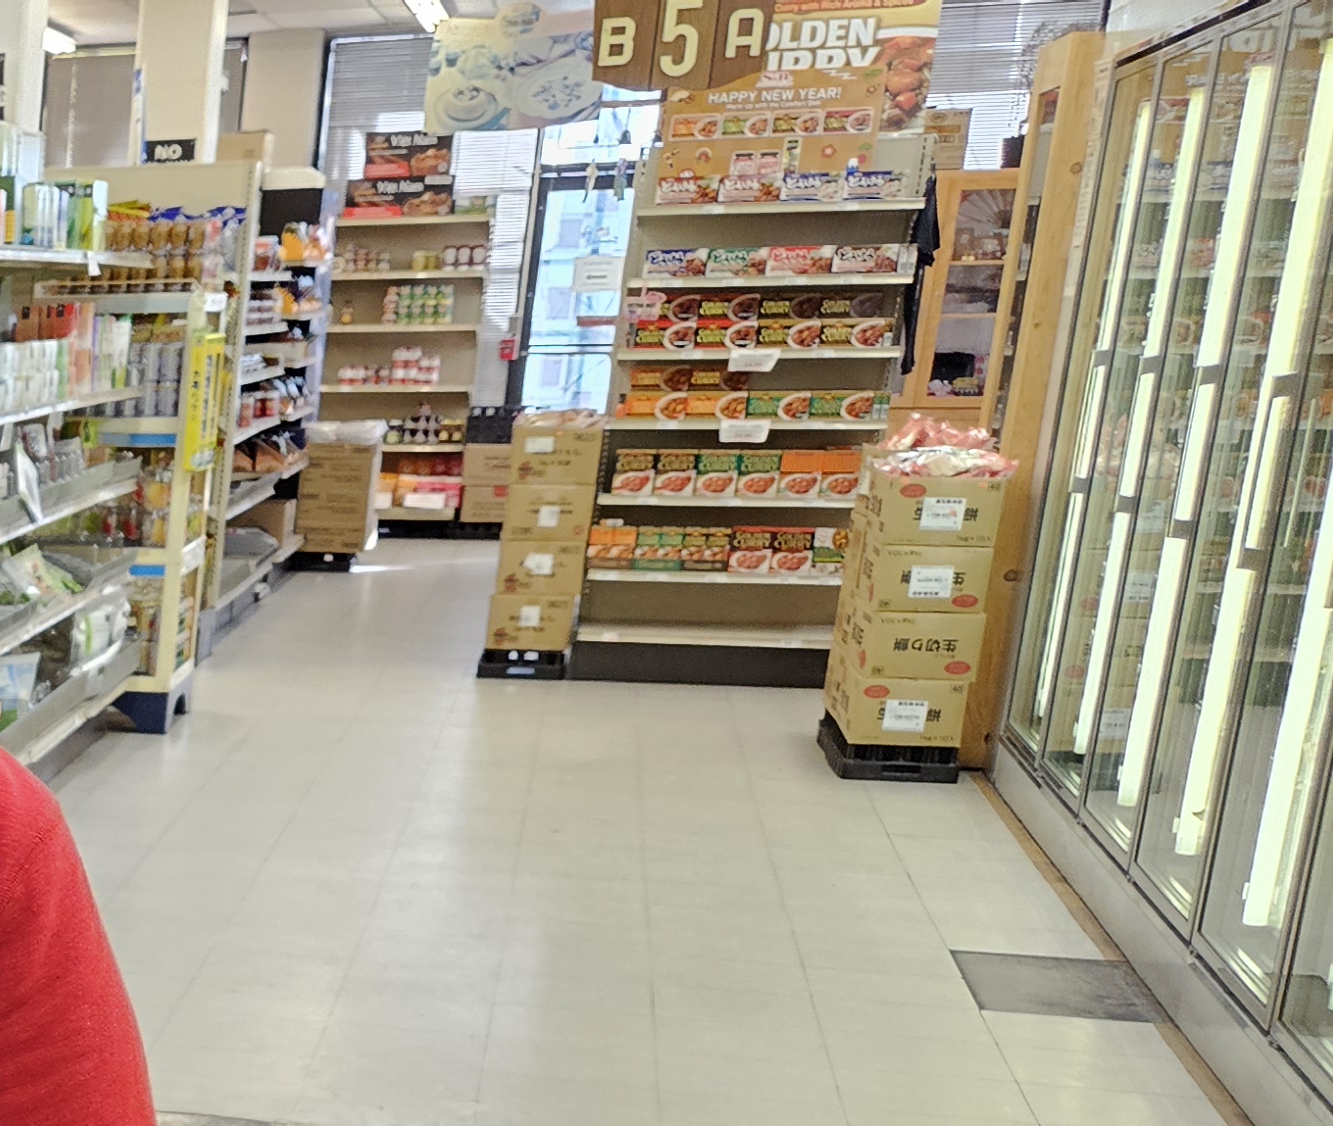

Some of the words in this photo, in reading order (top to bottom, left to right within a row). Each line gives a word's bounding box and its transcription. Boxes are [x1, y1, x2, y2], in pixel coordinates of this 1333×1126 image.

[597, 16, 636, 68] B
[659, 0, 703, 78] 5
[724, 8, 765, 59] A
[709, 89, 759, 105] HAPPY
[762, 88, 795, 103] NEW
[798, 86, 842, 101] YEAR!
[154, 143, 183, 160] NO
